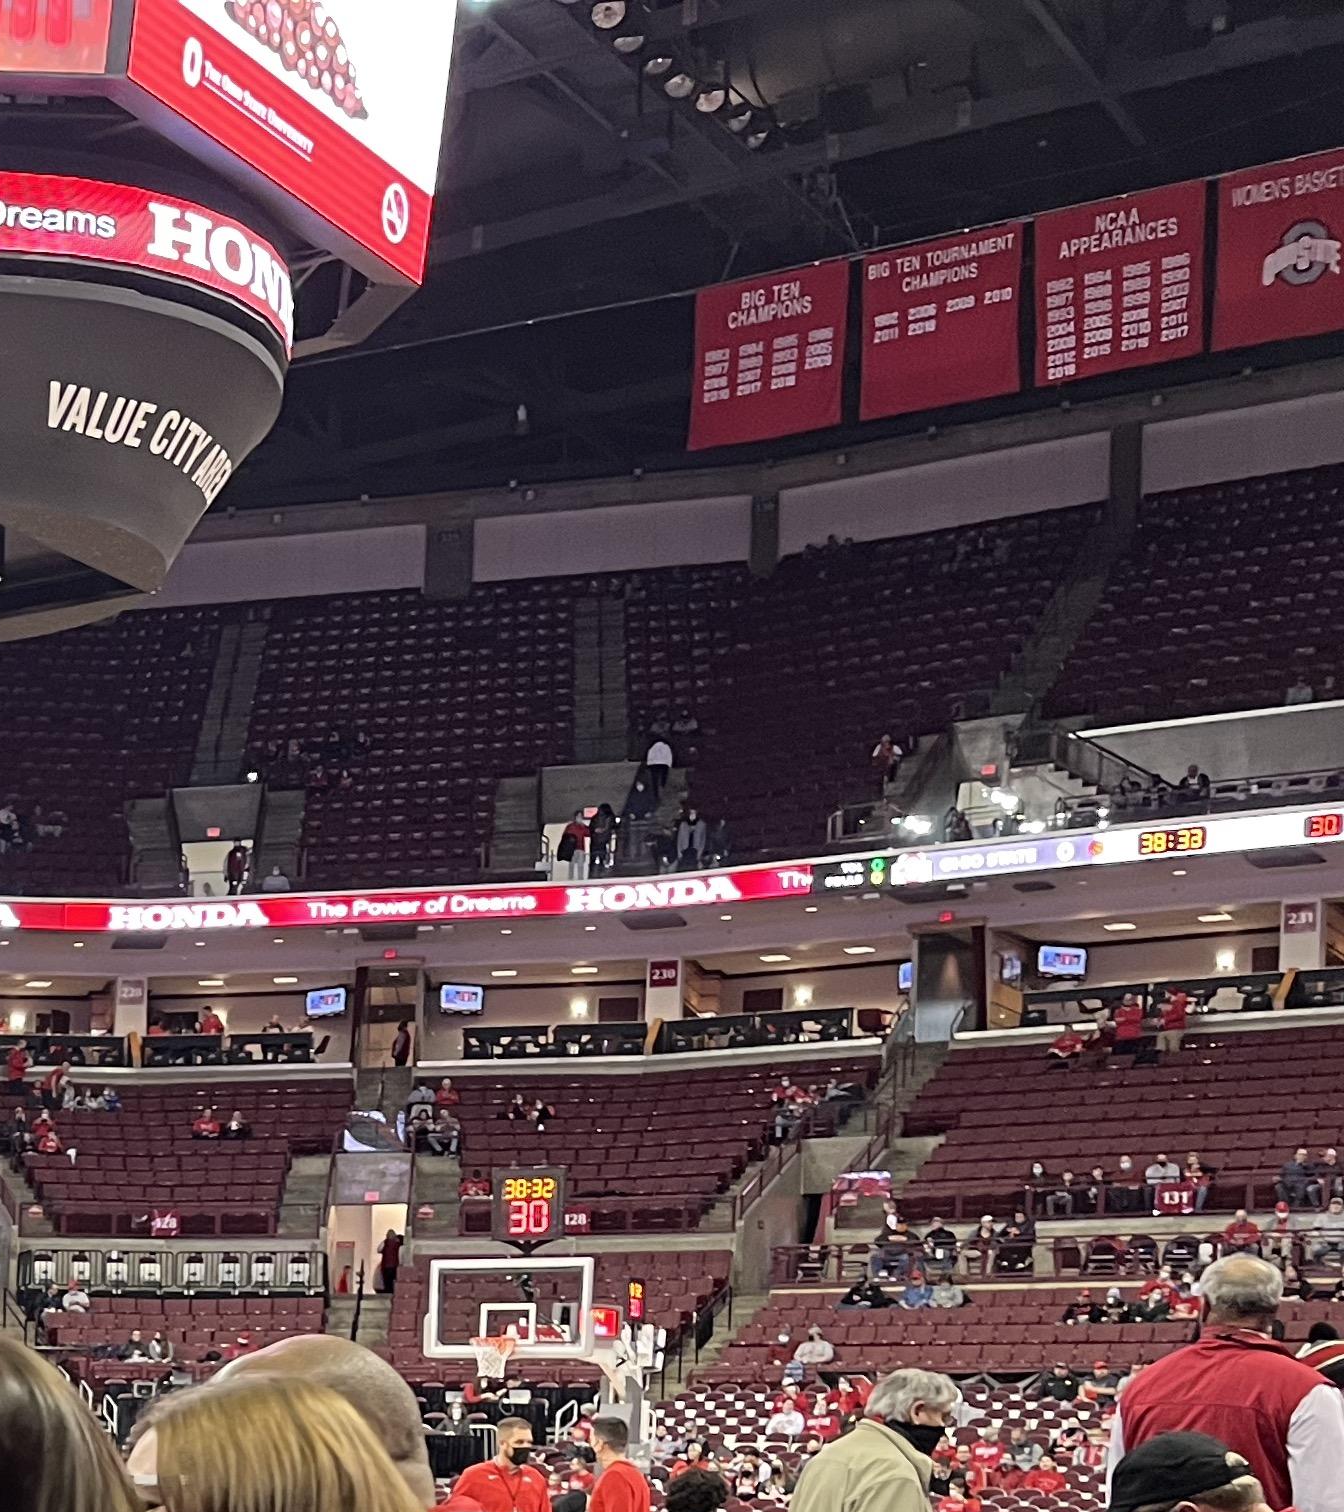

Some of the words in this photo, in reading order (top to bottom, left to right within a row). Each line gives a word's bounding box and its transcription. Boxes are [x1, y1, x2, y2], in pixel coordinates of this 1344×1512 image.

[1094, 207, 1140, 233] NCAA
[1058, 217, 1179, 260] APPEARANCES
[867, 262, 891, 280] BIG
[895, 255, 921, 274] TEN
[925, 233, 1015, 268] TOURNAMENT
[901, 262, 978, 293] CHAMPIONS
[740, 289, 766, 310] BIG
[772, 280, 801, 301] TEN
[727, 295, 813, 329] CHAMPIONS
[47, 380, 158, 448] VALUE
[149, 409, 213, 475] CITY
[1310, 815, 1338, 837] 30
[108, 903, 270, 929] HONDA
[306, 902, 346, 919] The
[352, 898, 422, 918] Power
[424, 896, 447, 914] of
[450, 893, 537, 913] Dreams
[565, 876, 742, 912] HONDA
[1286, 911, 1314, 925] 231
[651, 969, 677, 981] 230
[503, 1178, 557, 1199] 38:32
[1162, 1190, 1189, 1205] 131
[509, 1199, 549, 1233] 30
[564, 1213, 587, 1226] 128
